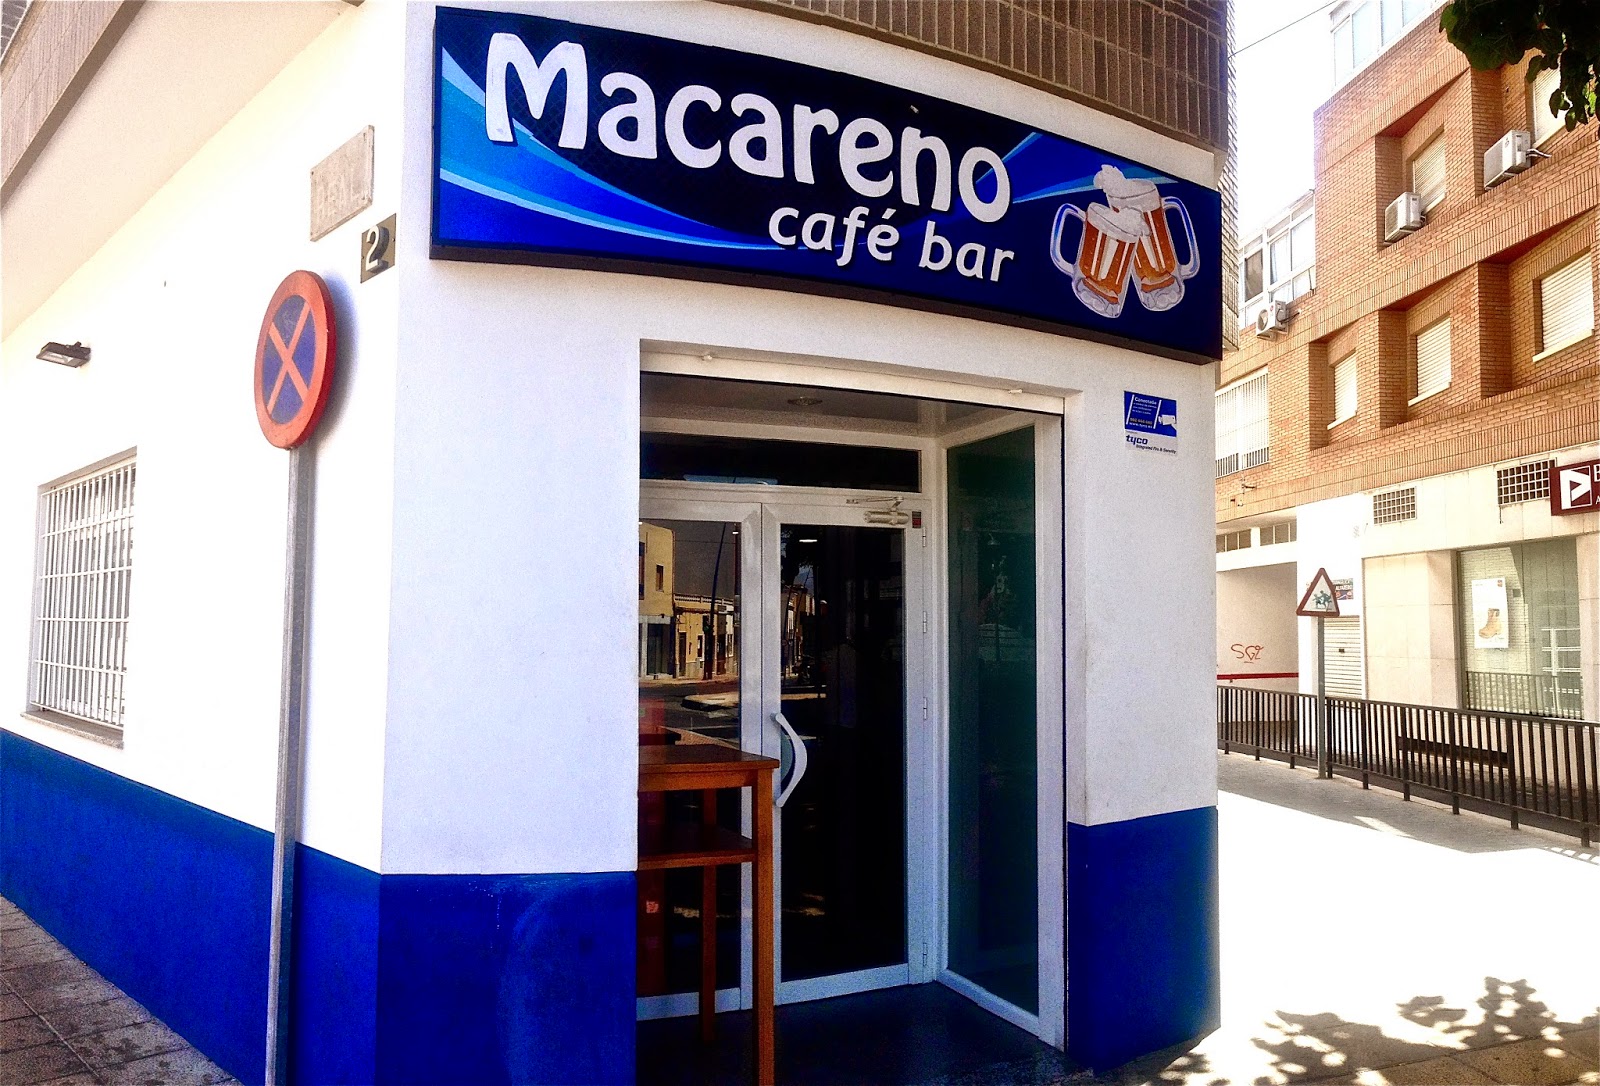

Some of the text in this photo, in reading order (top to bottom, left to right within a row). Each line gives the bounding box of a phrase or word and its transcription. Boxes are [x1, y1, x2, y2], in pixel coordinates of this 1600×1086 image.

[485, 31, 1011, 222] Macareno
[365, 224, 389, 274] 2
[768, 206, 1015, 282] café bar
[1126, 435, 1148, 445] tyco
